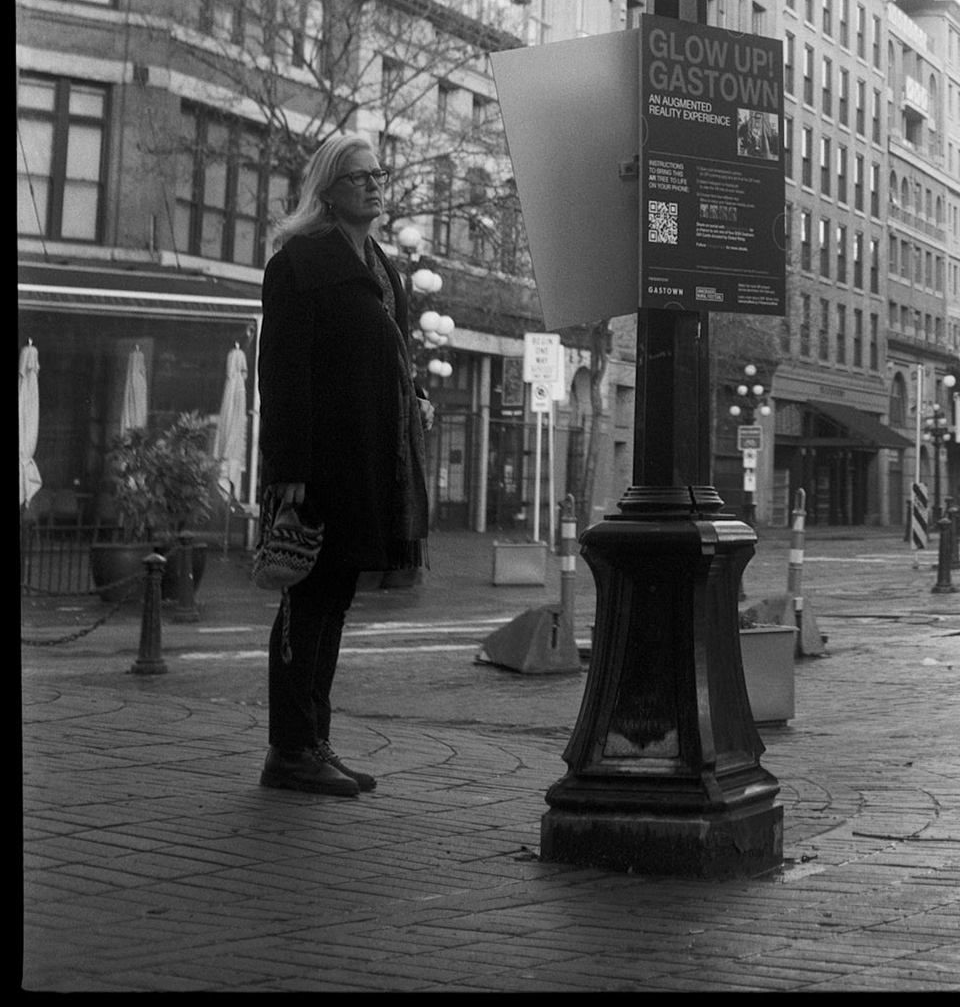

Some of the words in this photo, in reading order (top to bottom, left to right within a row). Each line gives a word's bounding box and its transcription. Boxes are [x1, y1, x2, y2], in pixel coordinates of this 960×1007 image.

[649, 28, 728, 68] GLOW
[734, 43, 774, 78] UP!
[649, 60, 778, 109] GASTOWN
[649, 94, 661, 104] AN
[661, 96, 712, 113] AUGMENTED
[649, 105, 682, 119] REALITY
[683, 110, 731, 127] EXPERIENCE
[648, 159, 684, 170] INSTRUCTIONS
[656, 168, 672, 176] BRING
[672, 170, 684, 178] THIS
[648, 174, 656, 182] AR
[656, 175, 669, 183] TREE
[669, 176, 677, 184] TO
[677, 177, 687, 185] LIFE
[648, 181, 657, 189] ON
[657, 182, 671, 191] YOUR
[648, 286, 684, 296] GASTOWN
